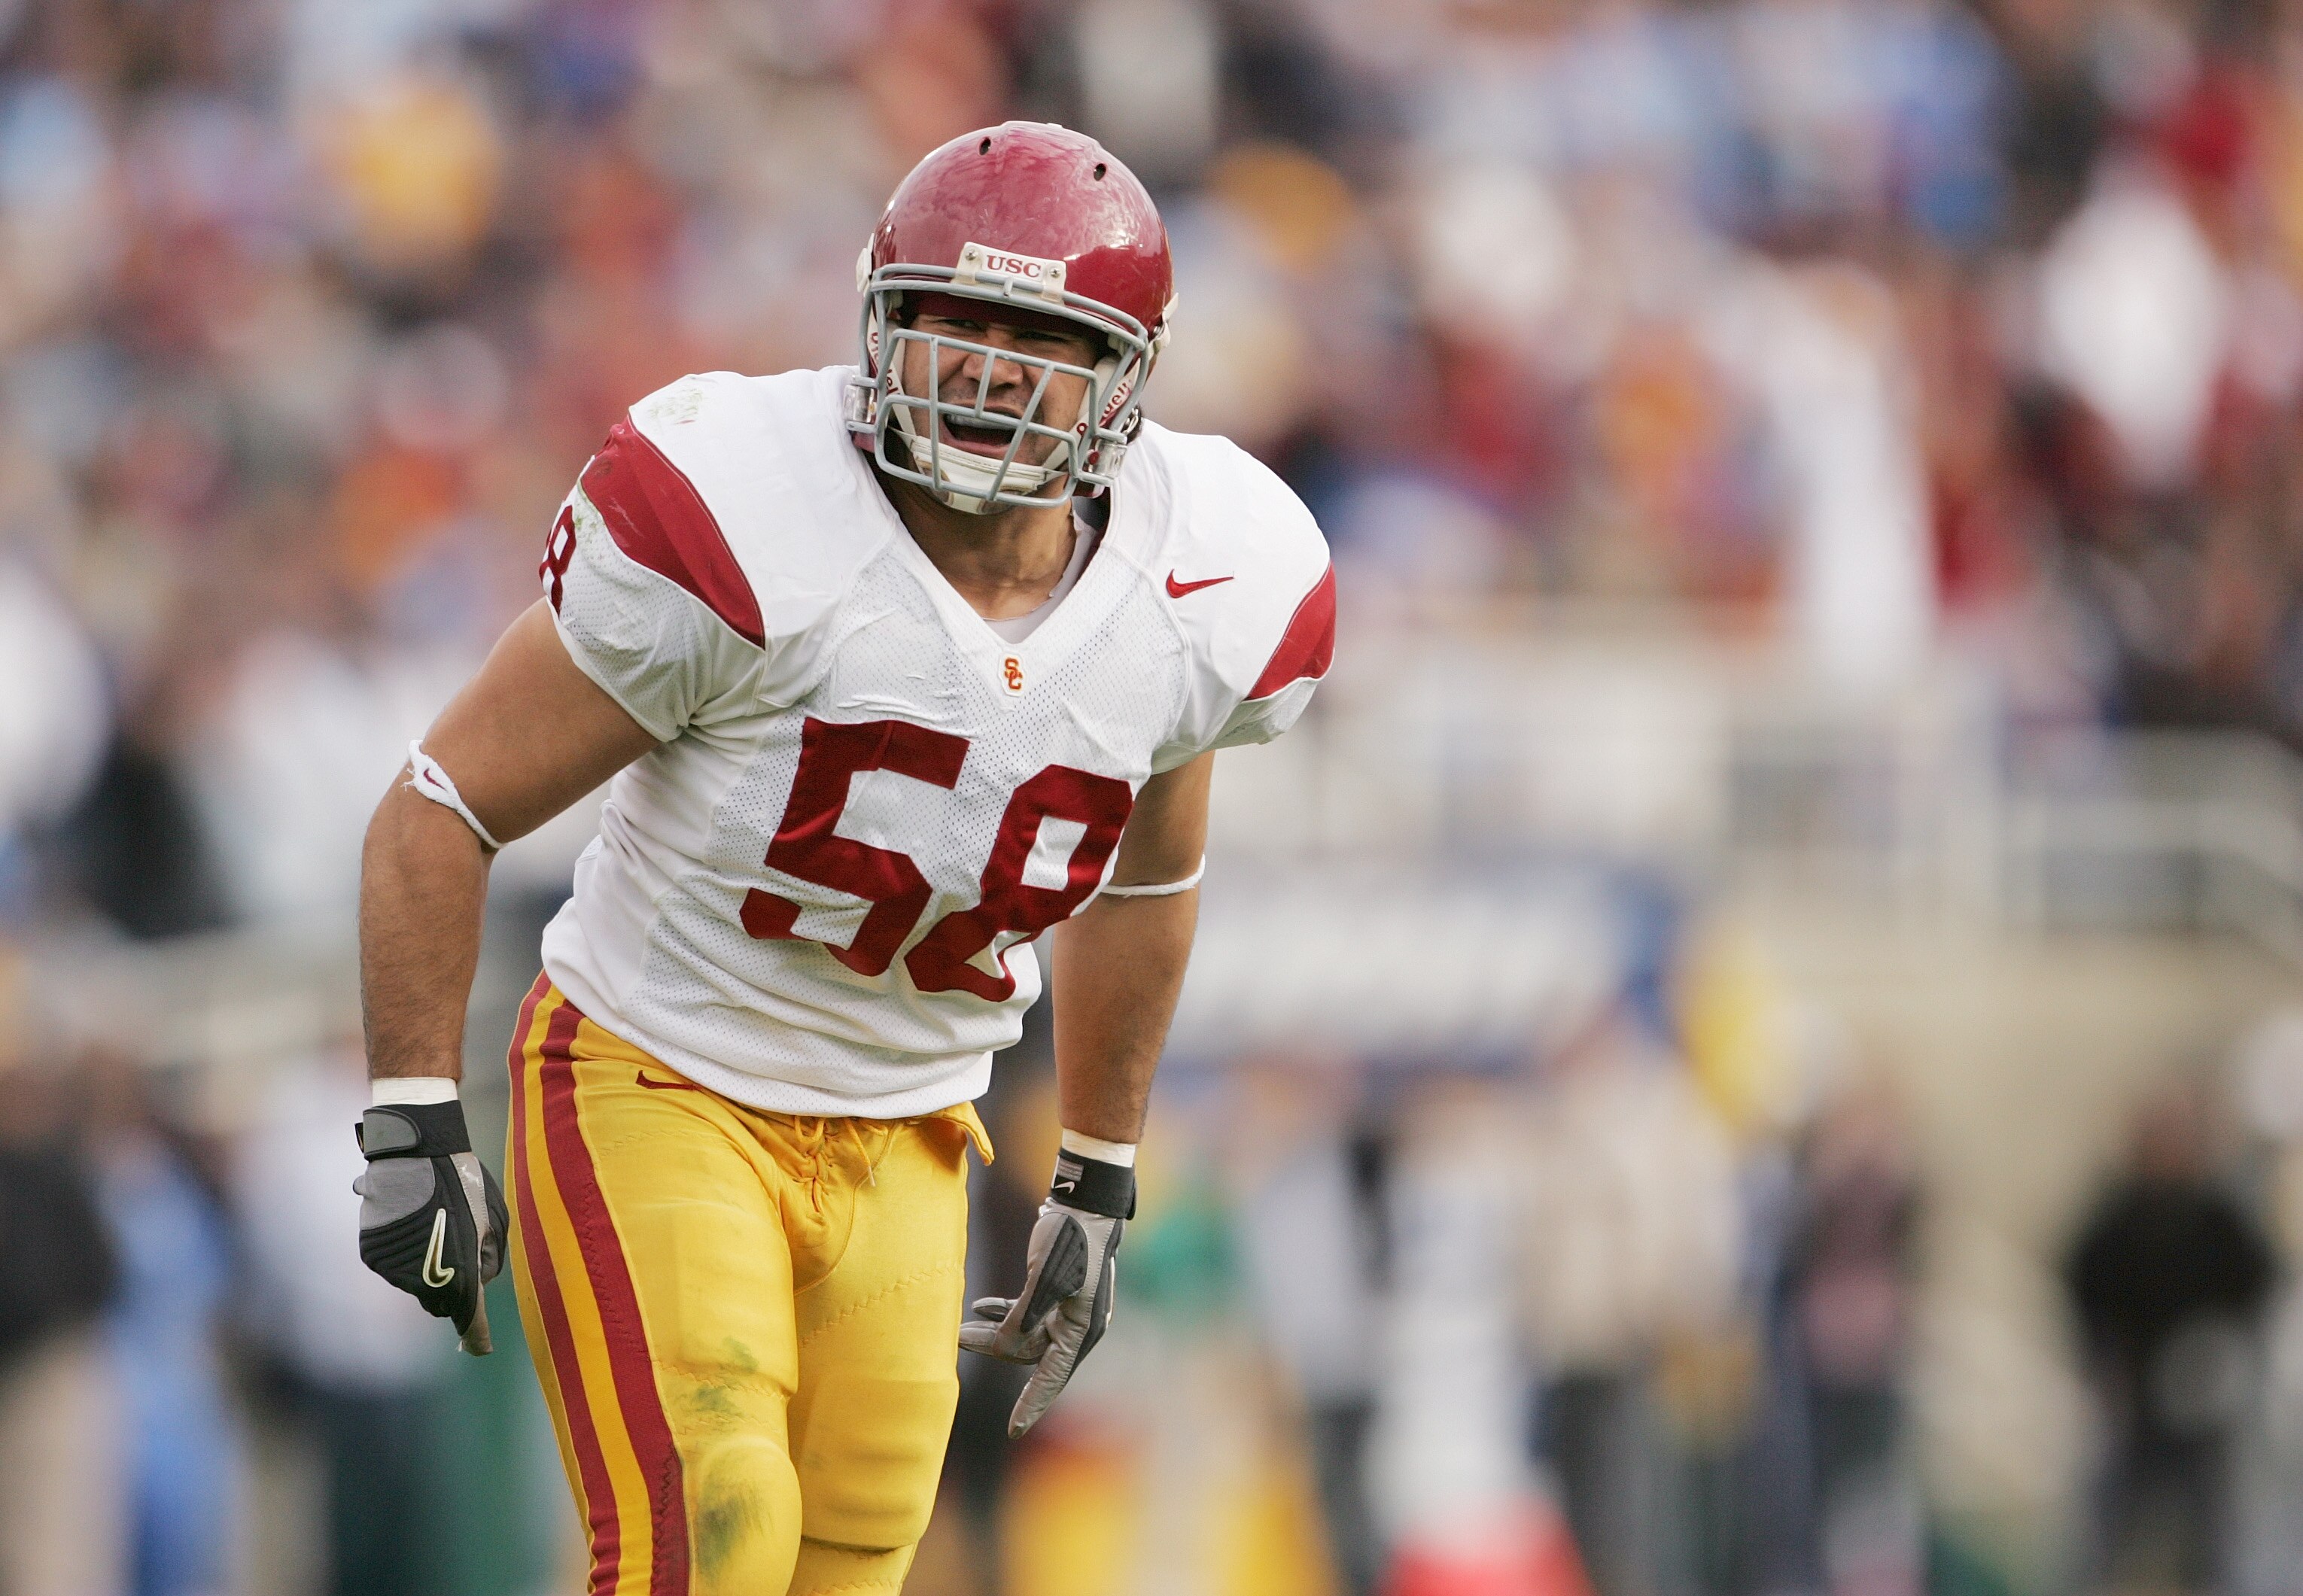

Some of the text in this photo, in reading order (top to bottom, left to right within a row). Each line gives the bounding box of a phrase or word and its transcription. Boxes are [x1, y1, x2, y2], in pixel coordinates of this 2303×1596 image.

[987, 254, 1041, 278] USC
[1005, 658, 1023, 690] SC
[740, 716, 1134, 1002] 58
